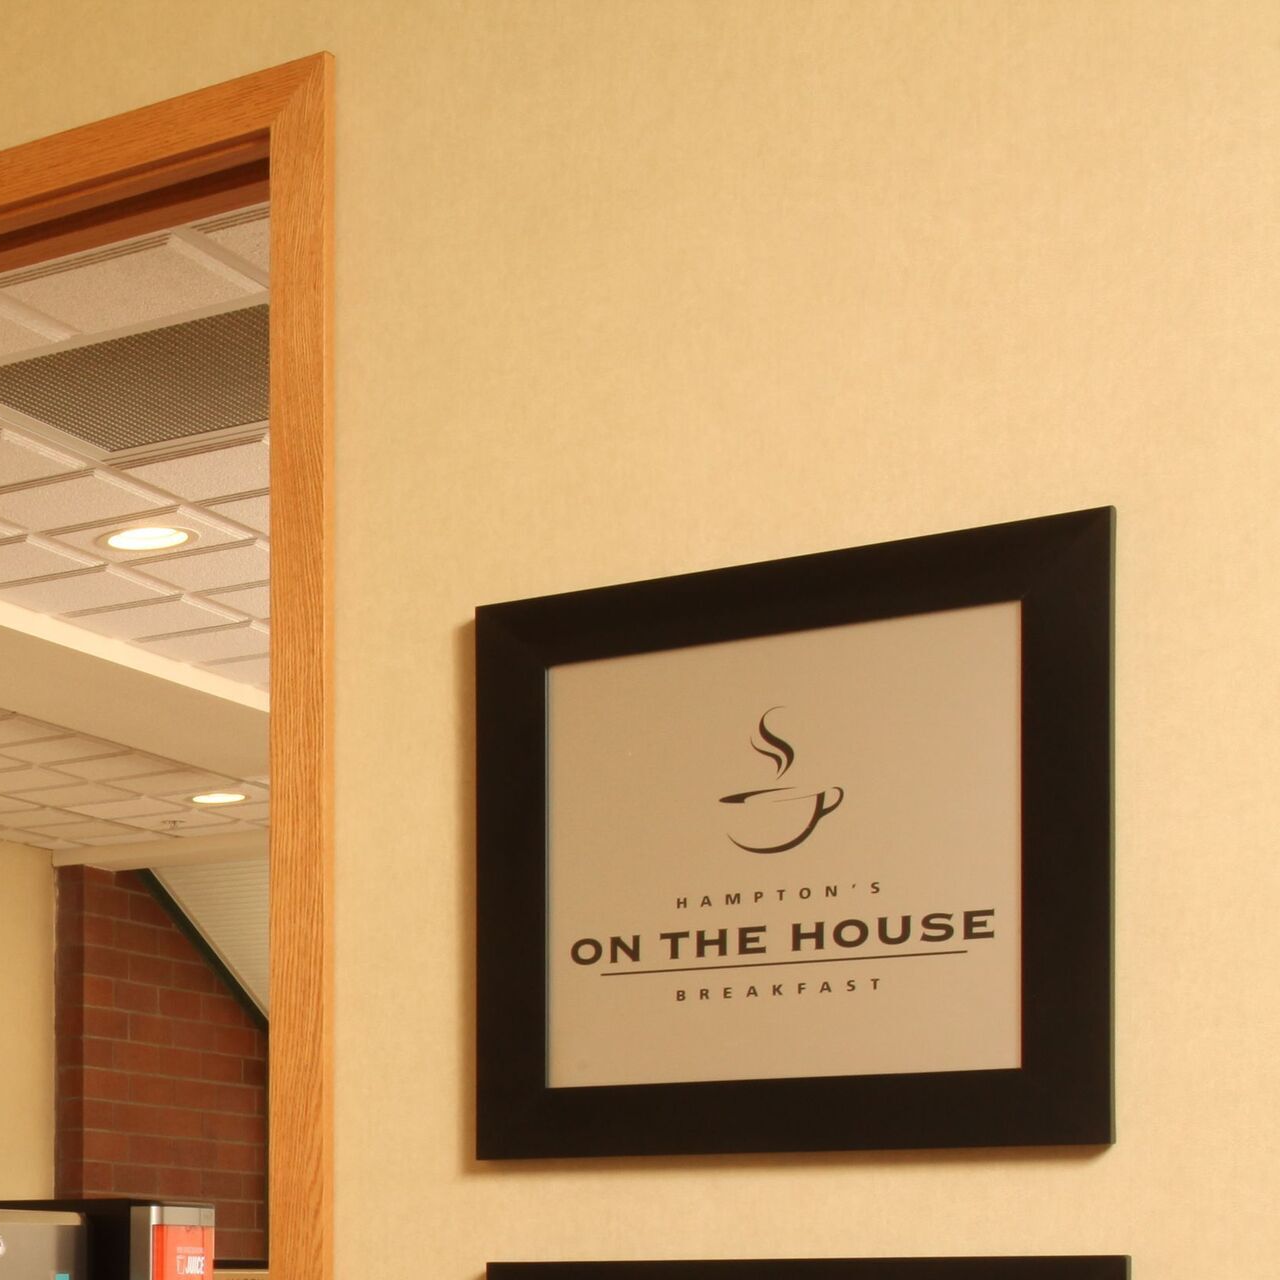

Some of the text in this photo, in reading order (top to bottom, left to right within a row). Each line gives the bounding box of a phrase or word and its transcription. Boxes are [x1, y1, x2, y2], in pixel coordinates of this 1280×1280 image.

[676, 881, 880, 910] HAMPTON'S
[570, 908, 996, 966] ON THE HOUSE
[676, 978, 880, 1002] BREAKFAST
